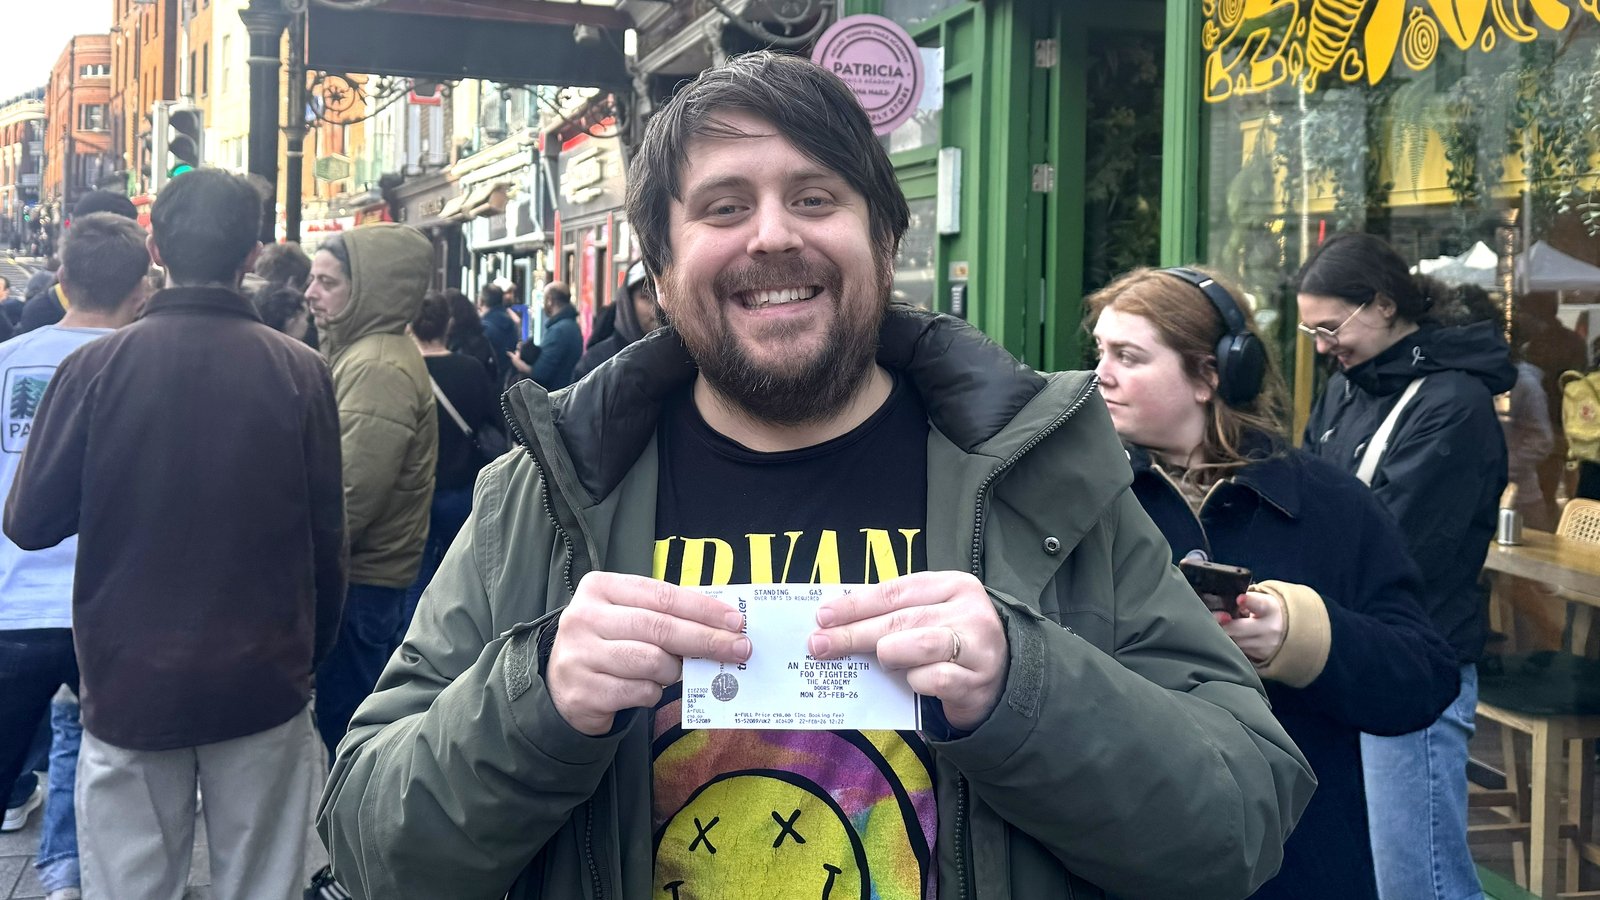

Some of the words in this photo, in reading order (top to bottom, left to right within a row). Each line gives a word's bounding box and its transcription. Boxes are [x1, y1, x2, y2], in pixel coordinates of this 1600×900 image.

[834, 62, 904, 78] PATRICIA
[871, 111, 888, 121] PLY
[889, 87, 910, 114] STORE
[10, 423, 32, 438] PA
[787, 662, 799, 670] AN
[804, 662, 843, 670] EVENING
[847, 662, 870, 670] WITH
[819, 671, 858, 679] FIGHTERS
